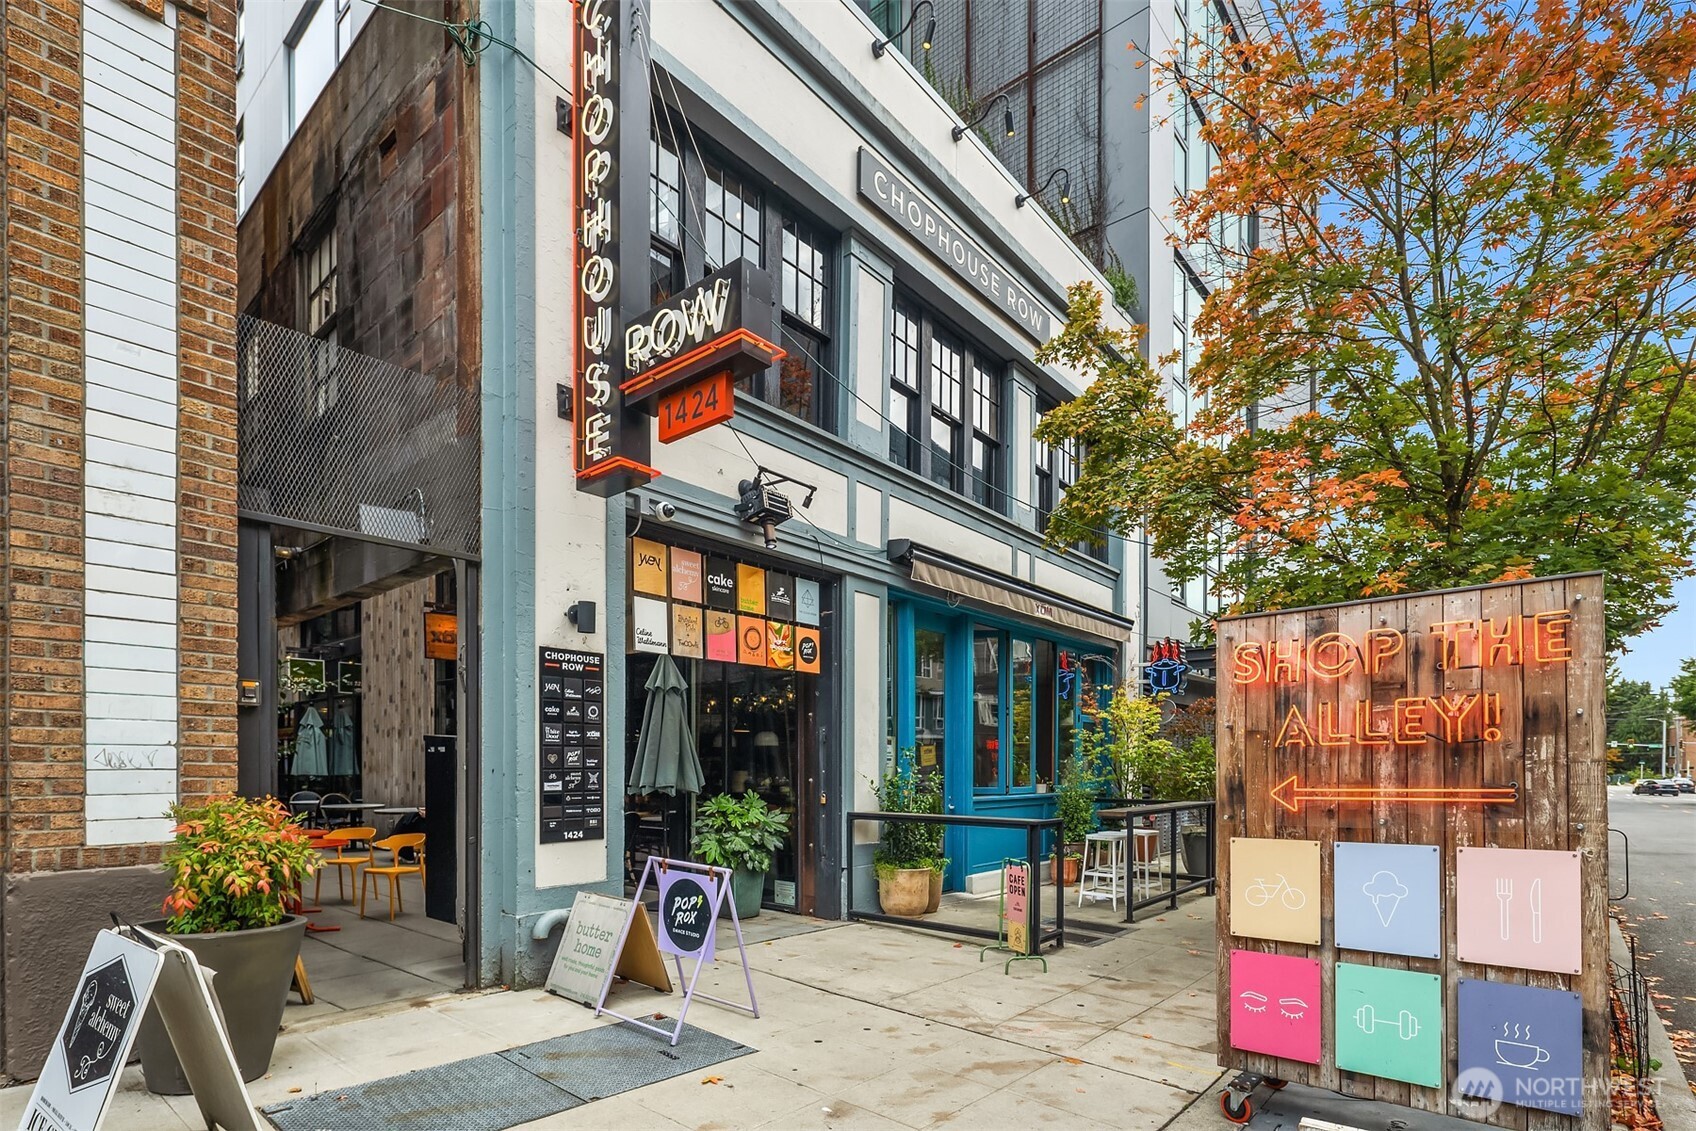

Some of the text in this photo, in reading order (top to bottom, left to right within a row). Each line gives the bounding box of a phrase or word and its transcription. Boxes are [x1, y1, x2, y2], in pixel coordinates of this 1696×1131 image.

[582, 0, 614, 461] CHOPHOUSE
[873, 171, 1044, 332] CHOPHOUSE ROW
[625, 278, 731, 375] ROW
[664, 383, 719, 430] 1424
[707, 574, 733, 588] cake
[711, 586, 730, 594] skincare
[1233, 609, 1573, 684] SHOP THE
[545, 651, 600, 665] CHOPHOUSE
[562, 662, 584, 672] ROW
[544, 705, 560, 713] cake
[1275, 693, 1501, 748] ALLEY!
[563, 831, 584, 839] 1424
[1008, 873, 1025, 886] CAFE
[1009, 885, 1026, 897] OPEN
[674, 911, 698, 927] ROX
[576, 920, 613, 942] butter
[685, 930, 700, 938] STUDIO
[573, 938, 602, 959] home
[106, 993, 131, 1019] sweet
[88, 1005, 122, 1043] alchemy
